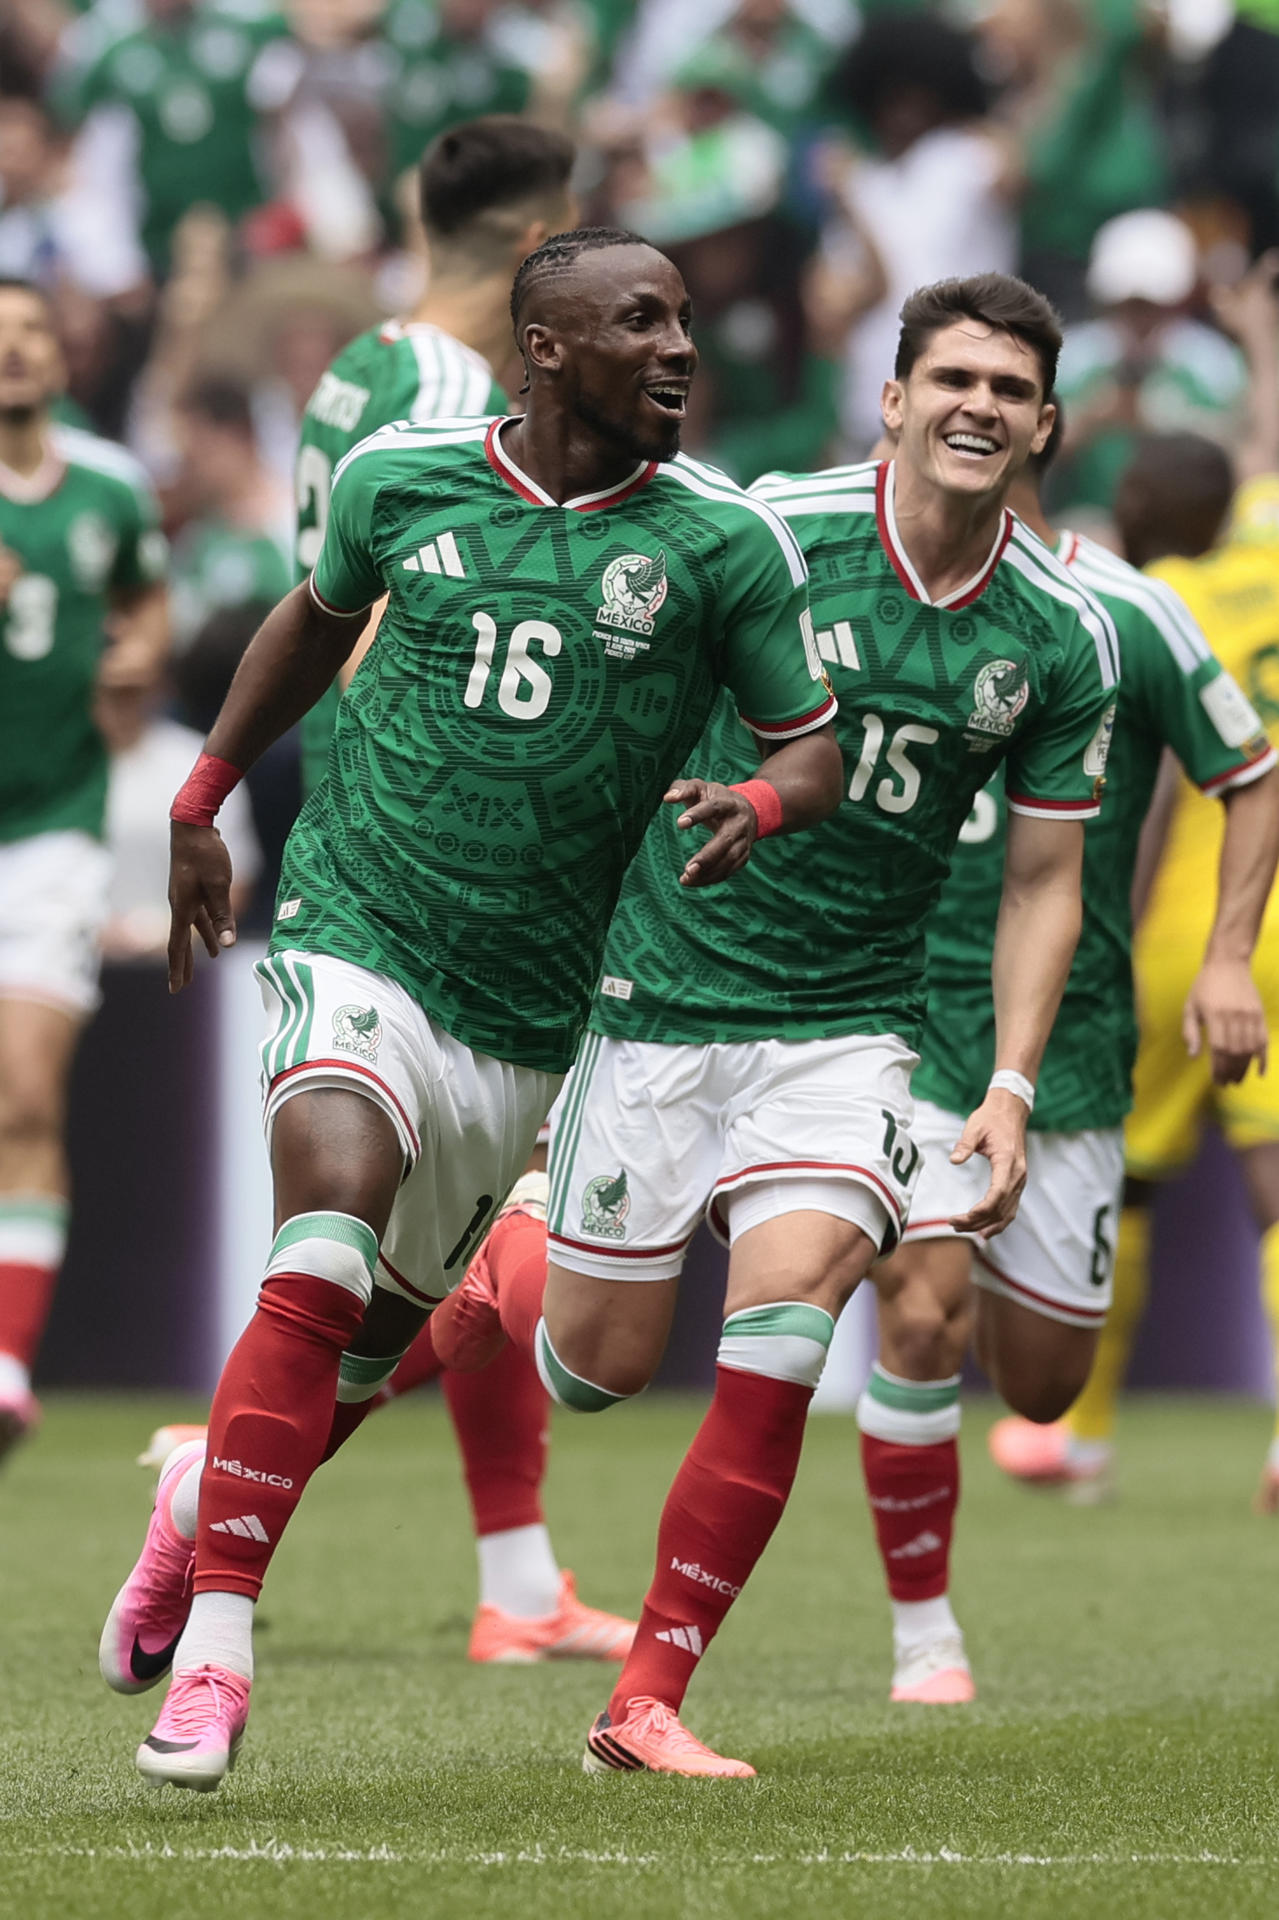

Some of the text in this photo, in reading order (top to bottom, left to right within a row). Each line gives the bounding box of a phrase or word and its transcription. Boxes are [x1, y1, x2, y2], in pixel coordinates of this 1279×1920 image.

[598, 609, 653, 633] MÉXICO
[463, 611, 562, 720] 16
[848, 713, 939, 814] 15
[212, 1456, 294, 1489] MÉXICO
[670, 1556, 741, 1598] MÉXICO
